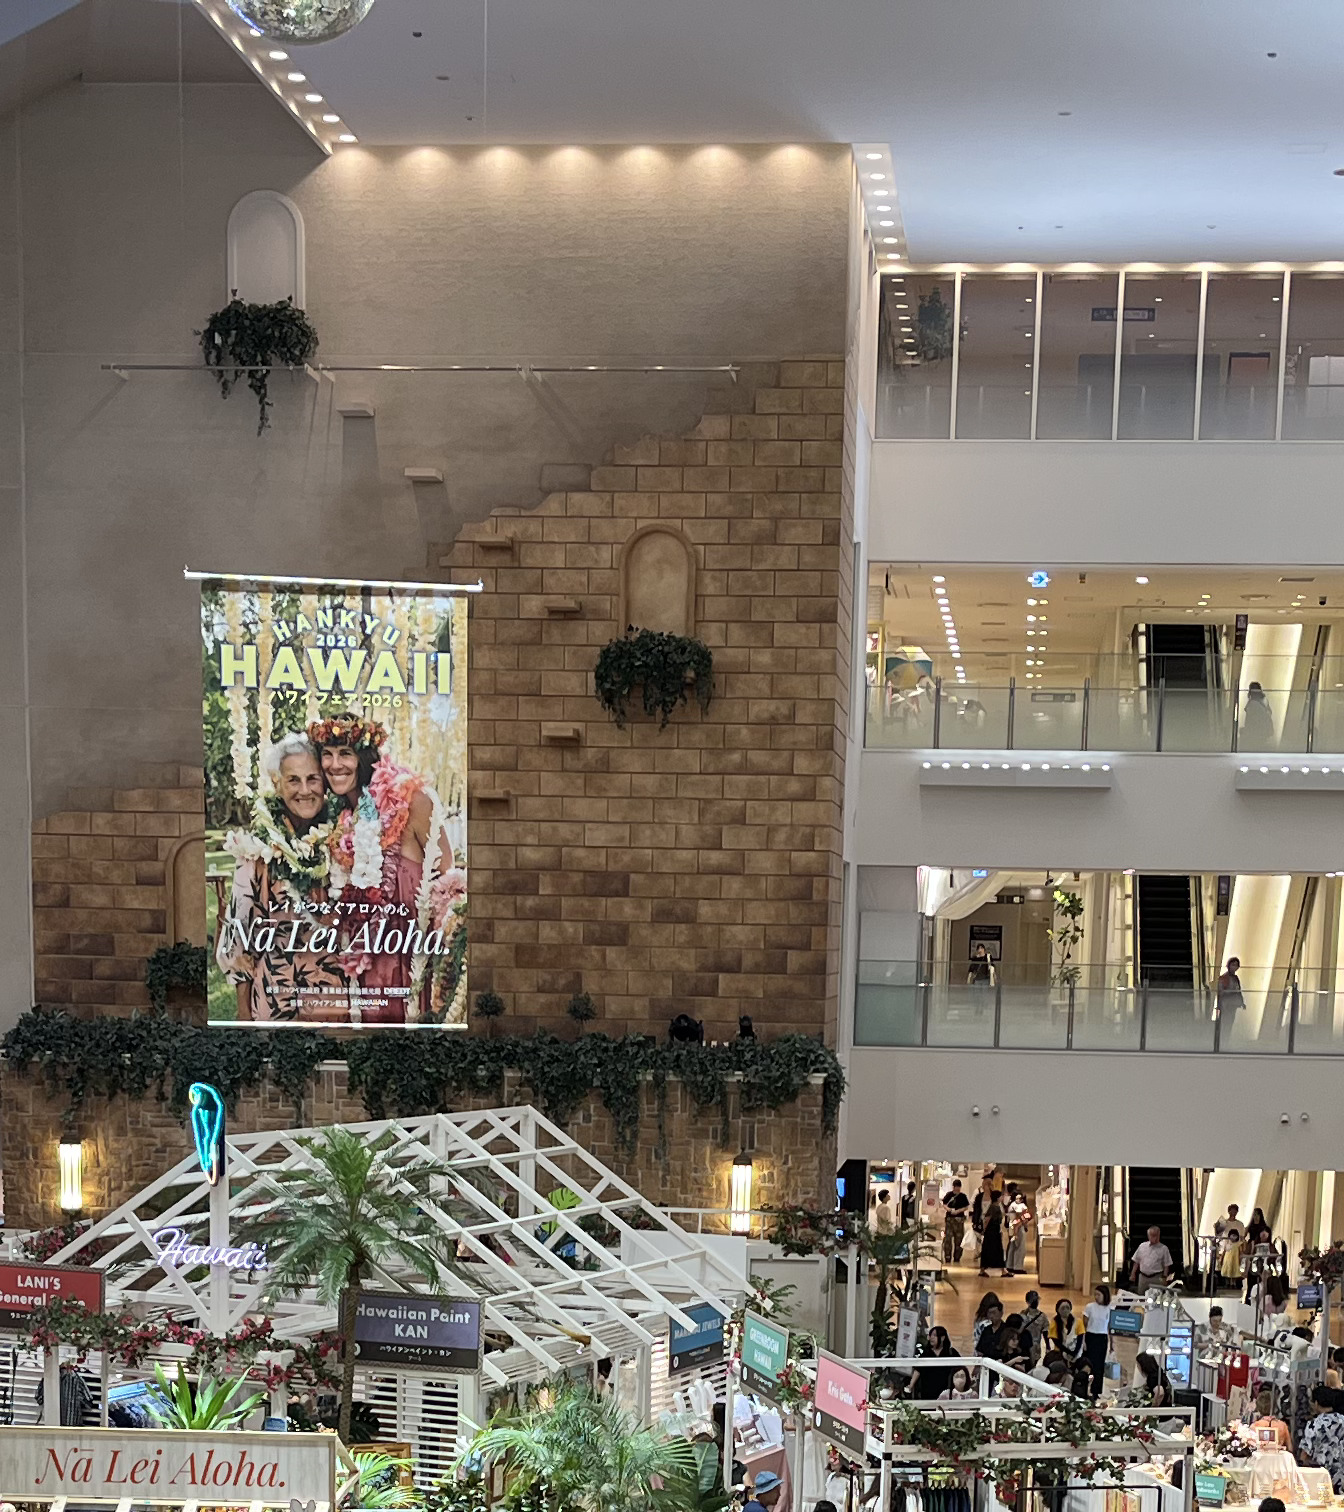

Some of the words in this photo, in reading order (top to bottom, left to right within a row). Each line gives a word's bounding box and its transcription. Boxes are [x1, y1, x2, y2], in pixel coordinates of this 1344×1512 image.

[272, 608, 402, 647] HANKYU
[316, 635, 357, 647] 2026
[268, 690, 358, 706] ハワイフェア
[362, 694, 403, 708] 2026
[268, 900, 410, 917] レイがつなぐアロハの心
[284, 918, 340, 954] Lei
[342, 918, 451, 956] Aloha.
[356, 1303, 427, 1321] Hawaiian
[430, 1308, 471, 1324] Paint
[394, 1323, 428, 1339] KAN
[34, 1446, 96, 1486] Nā
[103, 1448, 164, 1485] Lei
[168, 1448, 287, 1488] Aloha.
